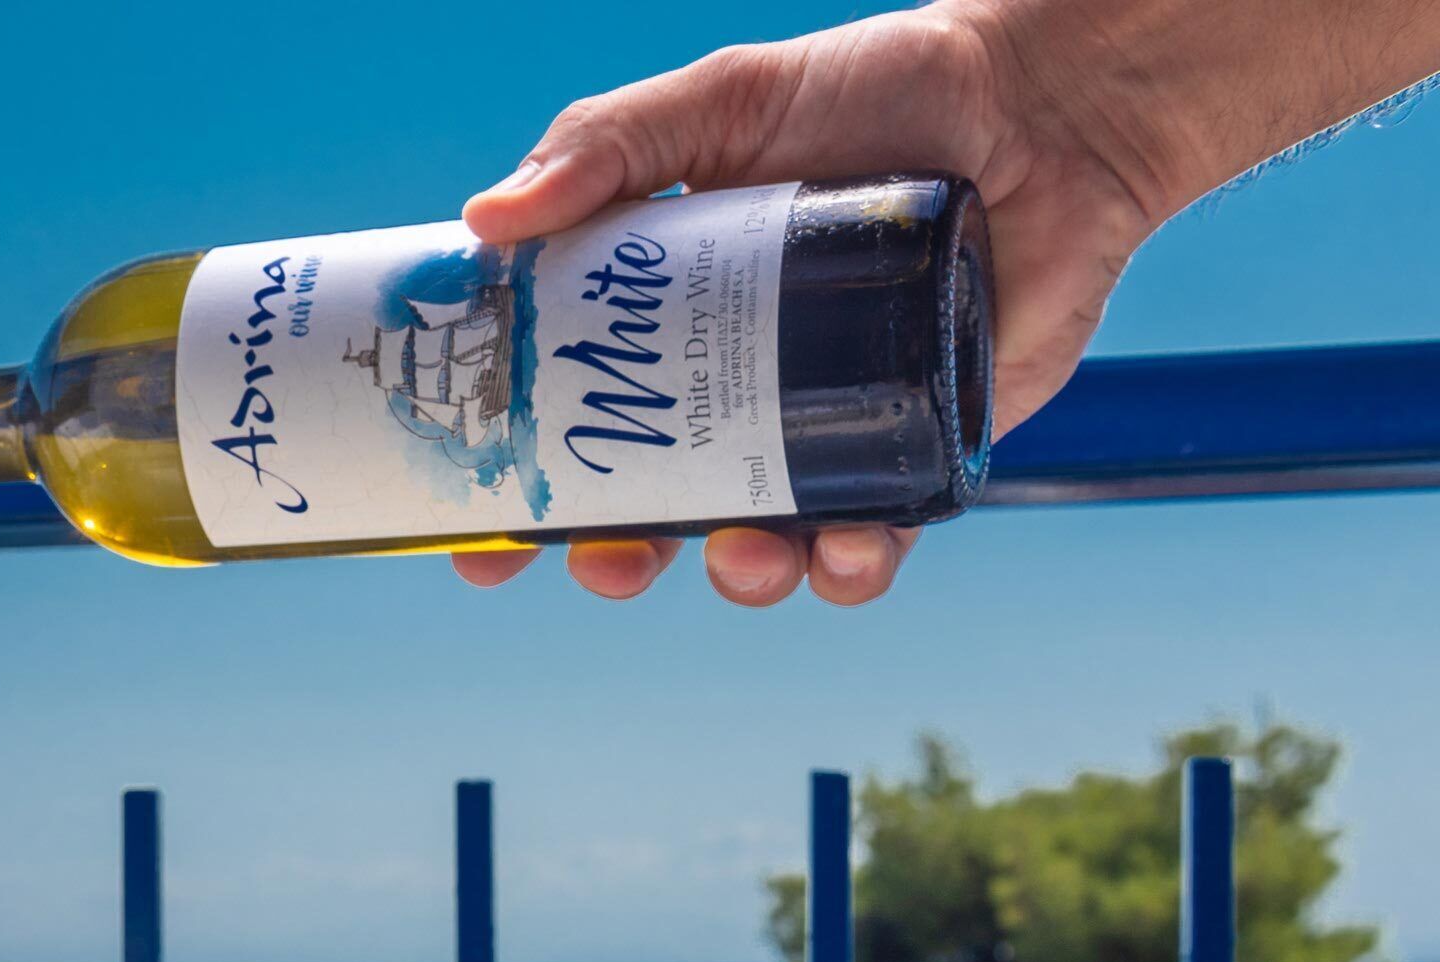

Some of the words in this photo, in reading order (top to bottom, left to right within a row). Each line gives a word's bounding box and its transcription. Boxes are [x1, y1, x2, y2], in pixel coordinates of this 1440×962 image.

[295, 254, 323, 294] wine
[686, 239, 715, 301] Wine
[747, 248, 761, 288] Sulfites
[289, 300, 314, 337] our
[730, 288, 743, 332] BEACH
[744, 291, 756, 336] Contains
[553, 232, 678, 473] White
[685, 308, 717, 361] Dry
[210, 256, 308, 513] Adrina
[718, 350, 730, 378] from
[731, 335, 743, 389] ADRINA
[744, 347, 758, 393] Product
[687, 370, 714, 449] White
[718, 381, 732, 420] Bottled
[732, 392, 744, 408] for
[747, 394, 759, 426] Greek
[743, 455, 773, 507] 750ml
